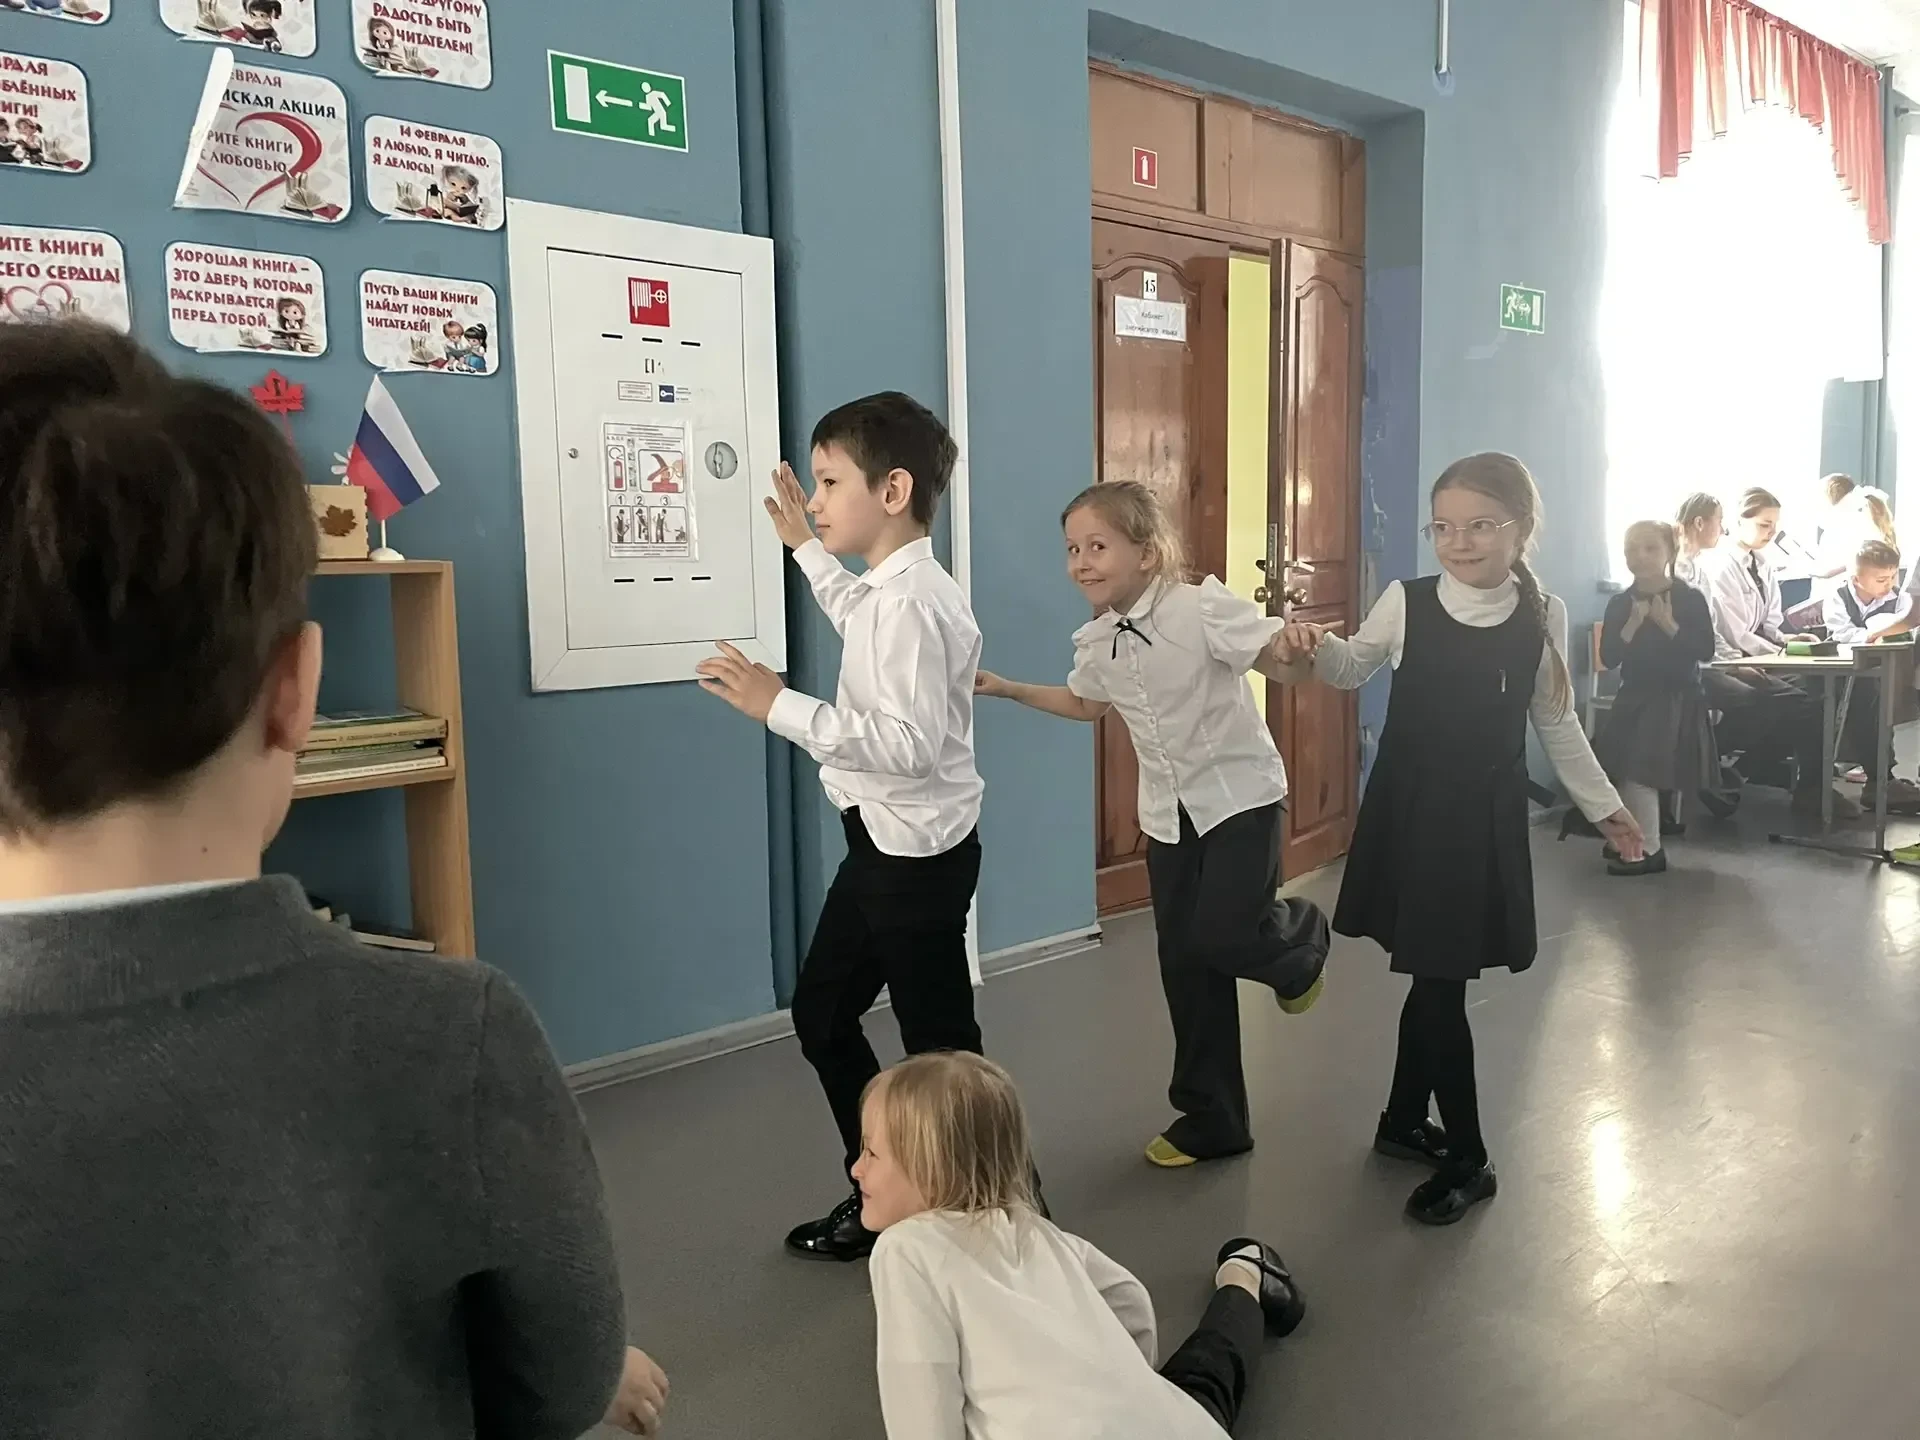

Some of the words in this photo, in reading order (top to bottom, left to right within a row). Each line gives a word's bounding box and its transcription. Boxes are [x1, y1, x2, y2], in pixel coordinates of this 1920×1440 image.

[373, 3, 433, 26] РАДОСТЬ
[436, 16, 472, 34] БЫТЬ
[396, 28, 473, 55] ЧИТАТЕЛЕМ!
[0, 56, 48, 76] РАЛЯ
[280, 98, 336, 119] АКЦИЯ
[245, 136, 293, 154] КНИГИ
[400, 125, 411, 137] 14
[415, 129, 466, 147] ФЕВРАЛЯ
[210, 151, 287, 173] ЛЮБОВЬЮ
[373, 137, 381, 149] Я
[384, 139, 431, 158] ЛЮБЛЮ.
[435, 149, 443, 160] Я
[446, 150, 489, 168] ЧИТАЮ.
[373, 153, 381, 165] Я
[385, 156, 435, 175] ДЕЛЮСЬ!
[40, 239, 104, 257] КНИГИ
[174, 248, 248, 268] ХОРОШАЯ
[253, 257, 297, 274] КНИГА
[46, 265, 120, 283] СЕРДЦА!
[174, 268, 200, 282] ЭТО
[253, 278, 313, 295] КОТОРАЯ
[403, 287, 438, 301] ВАШИ
[1145, 279, 1155, 292] 15
[170, 288, 275, 309] РАСКРЫВАЕТСЯ
[365, 298, 408, 314] НАЙДУТ
[412, 304, 453, 318] НОВЫХ
[172, 308, 217, 323] ПЕРЕД
[220, 312, 271, 329] ТОБОЙ.
[367, 316, 431, 333] ЧИТАТЕЛЕЙ!
